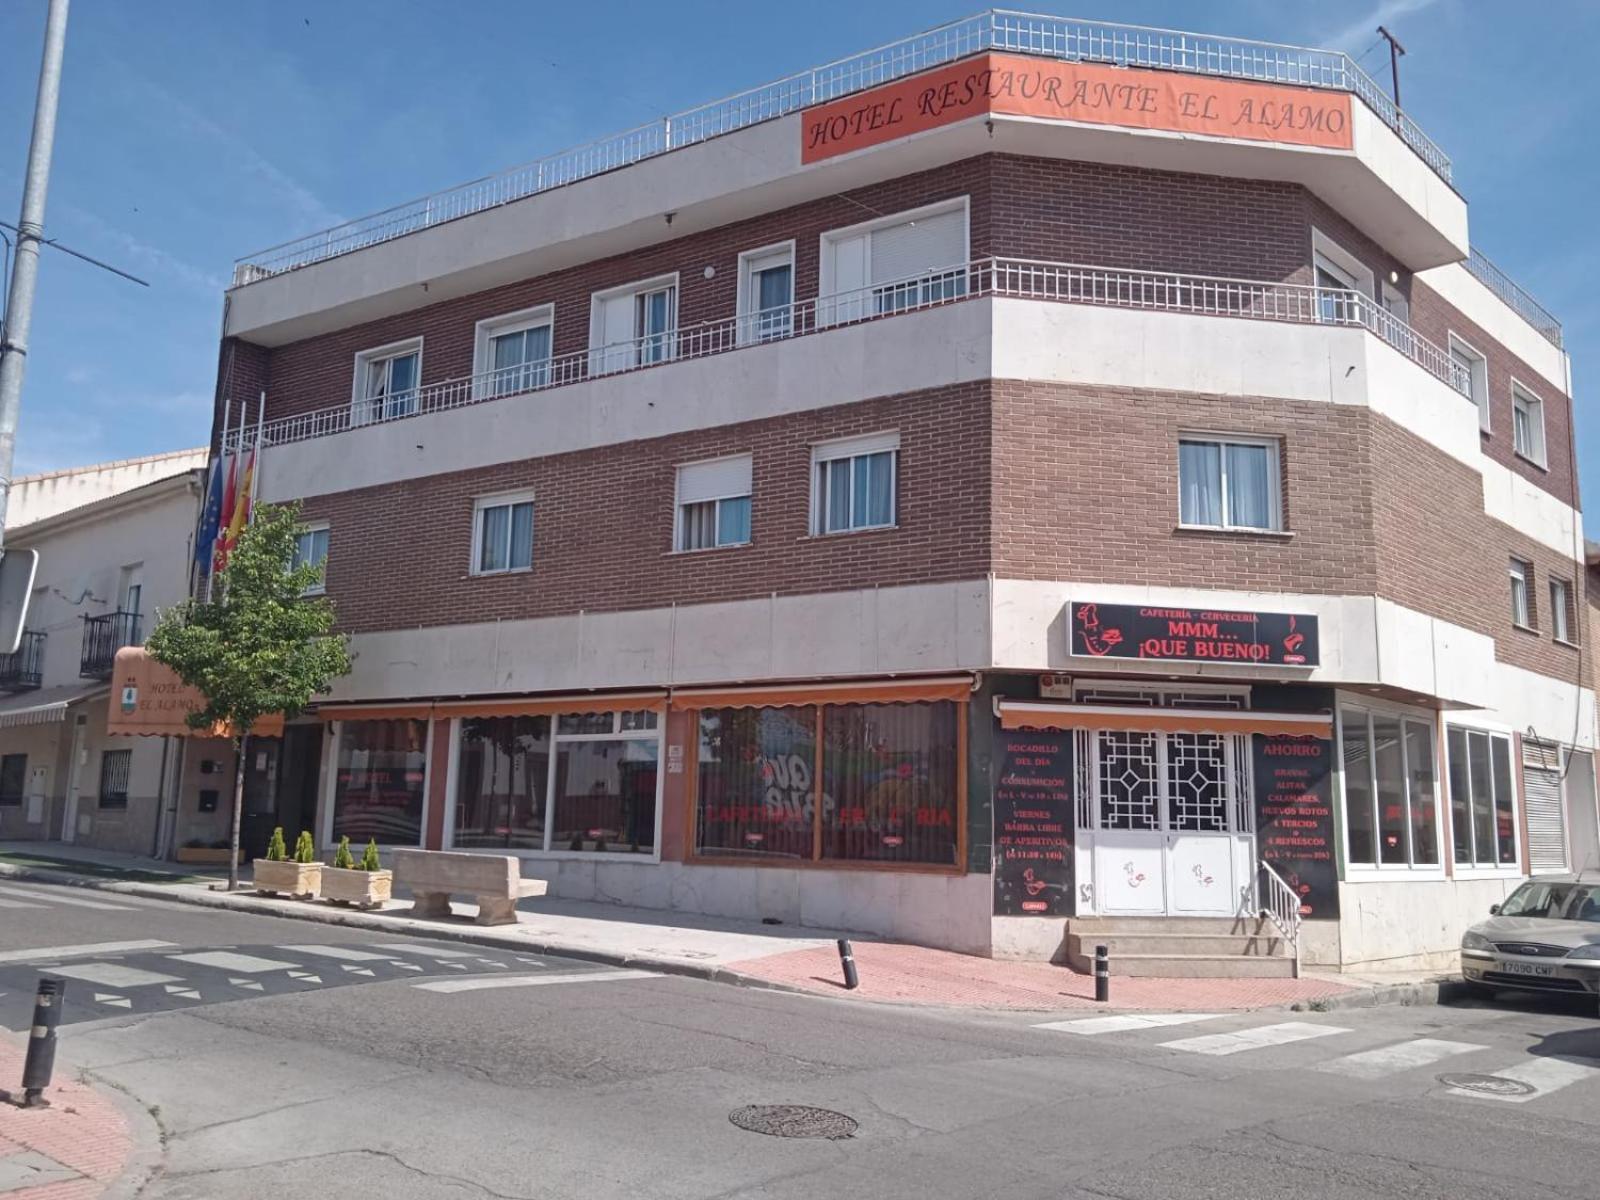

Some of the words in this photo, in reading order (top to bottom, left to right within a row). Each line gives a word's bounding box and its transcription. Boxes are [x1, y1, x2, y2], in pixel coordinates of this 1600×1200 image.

[808, 97, 904, 149] HOTEL
[917, 68, 1159, 117] RESTAURANTE
[1177, 92, 1220, 121] EL
[1236, 98, 1346, 135] ALAMO
[1168, 621, 1239, 640] MMM...
[1139, 639, 1188, 659] ¡QUE
[1194, 643, 1271, 660] BUENO!
[151, 682, 185, 696] HOTEL
[1007, 744, 1058, 753] BOCADILLO
[1264, 744, 1321, 757] AHORRO
[1015, 758, 1032, 766] DEL
[1013, 810, 1051, 819] VIERNES
[1299, 807, 1329, 816] ROTOS
[1281, 819, 1318, 828] TERCIOS
[1274, 837, 1326, 846] REFRESCOS
